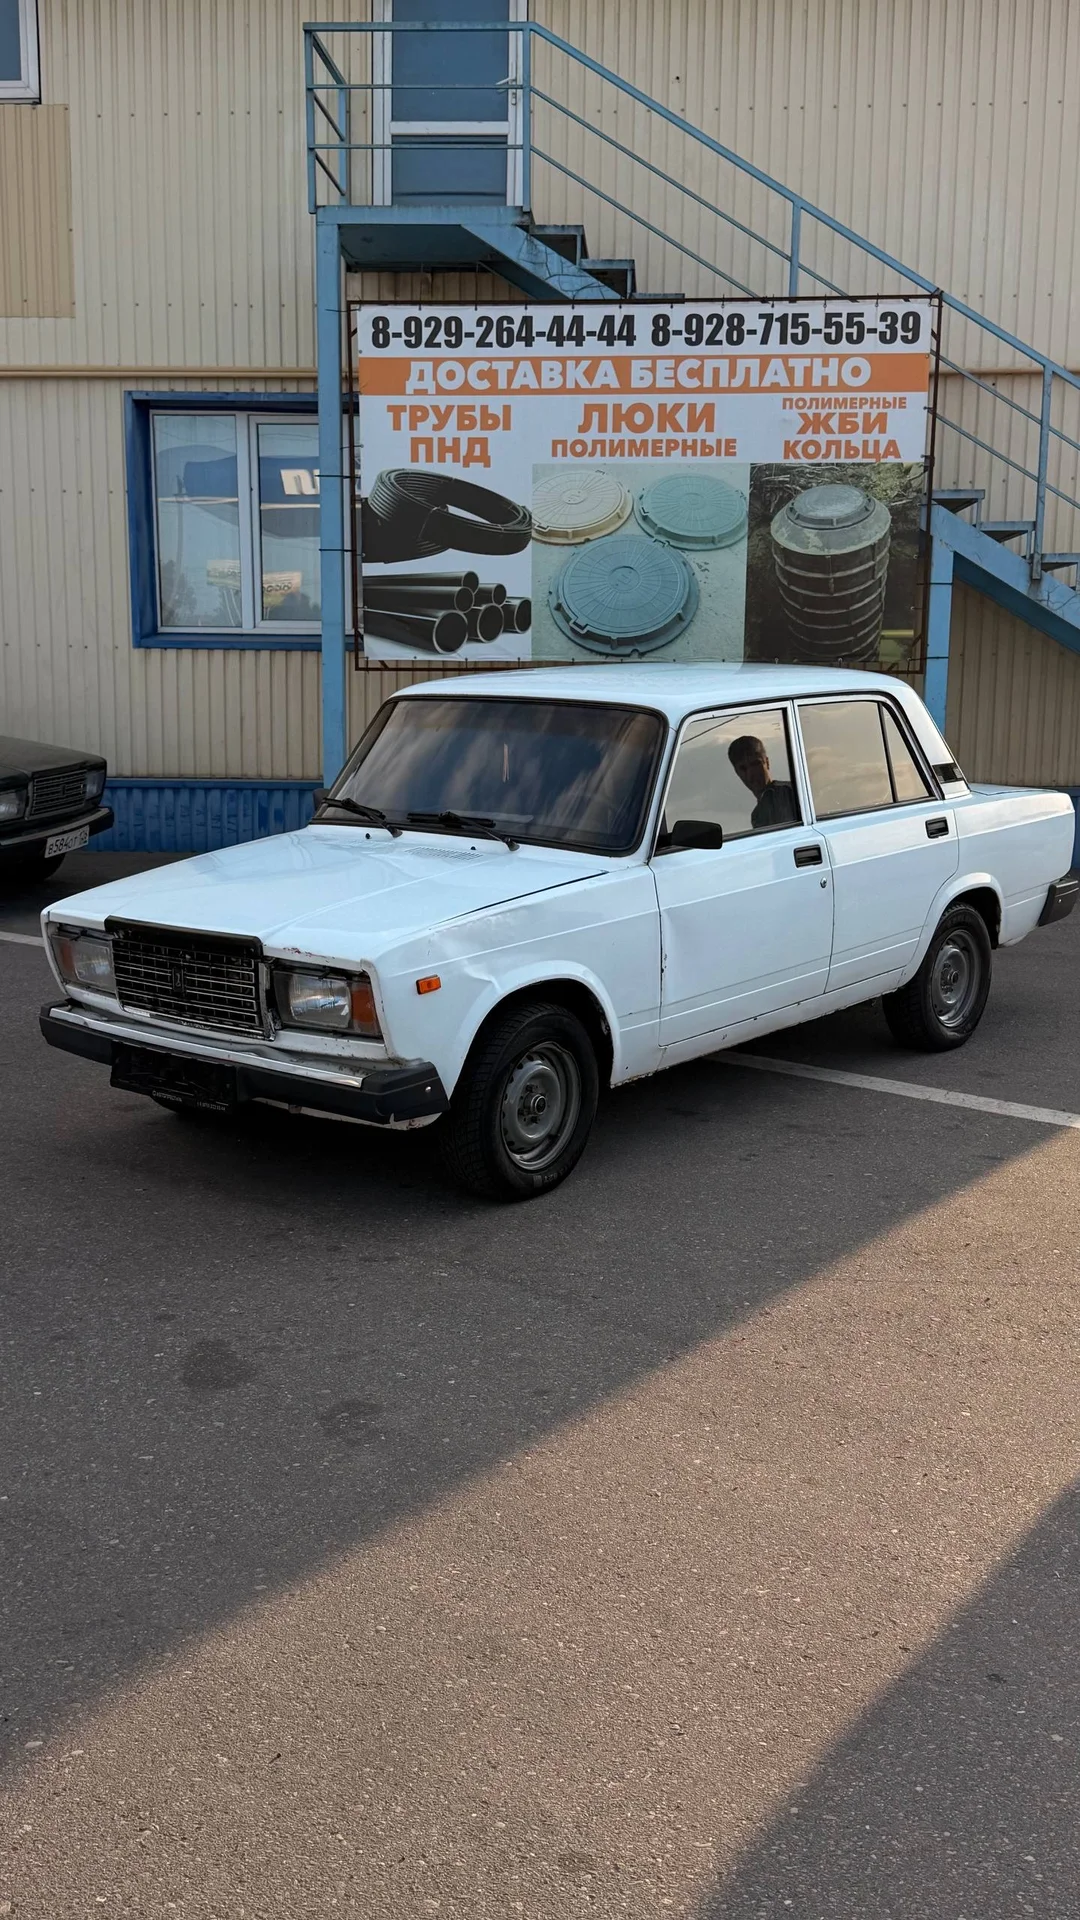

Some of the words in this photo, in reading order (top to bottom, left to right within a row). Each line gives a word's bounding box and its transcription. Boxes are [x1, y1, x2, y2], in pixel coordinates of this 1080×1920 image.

[372, 315, 636, 348] 8-929-264-44-44
[652, 311, 921, 346] 8-928-715-55-39
[405, 360, 620, 394] ДОСТАВКА
[631, 357, 871, 388] БЕСПЛАТНО
[782, 396, 907, 410] ПОЛИМЕРНЫЕ
[387, 404, 512, 431] ТРУБЫ
[577, 402, 716, 433] ЛЮКИ
[796, 412, 888, 434] ЖБИ
[410, 437, 491, 468] ПНД
[551, 438, 737, 458] ПОЛИМЕРНЫЕ
[783, 439, 901, 463] КОЛЬЦА
